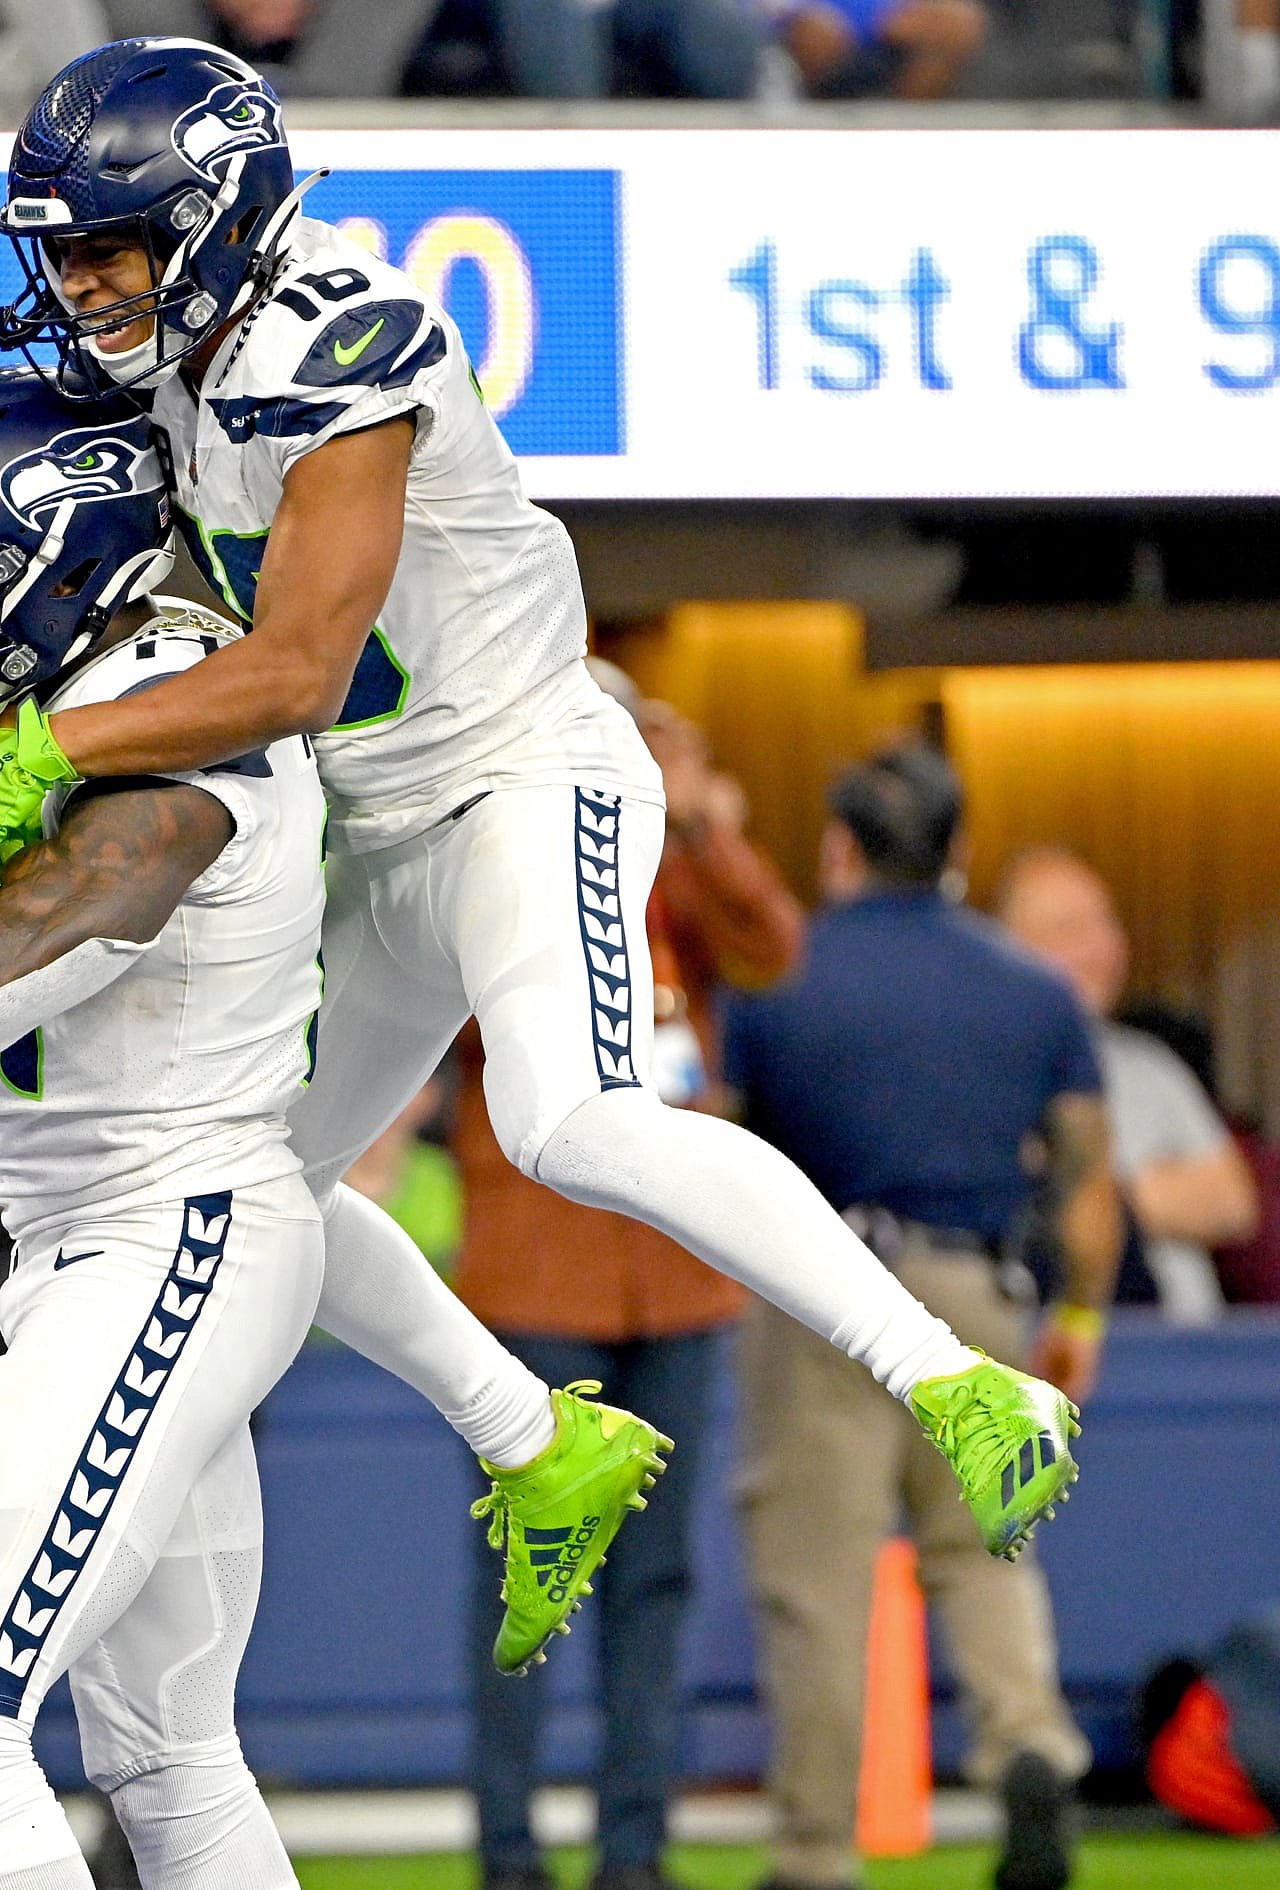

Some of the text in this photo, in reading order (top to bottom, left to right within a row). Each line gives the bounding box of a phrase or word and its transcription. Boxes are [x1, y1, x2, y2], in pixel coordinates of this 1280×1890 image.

[728, 235, 1280, 393] 1st & 9
[547, 1515, 601, 1604] adidas
